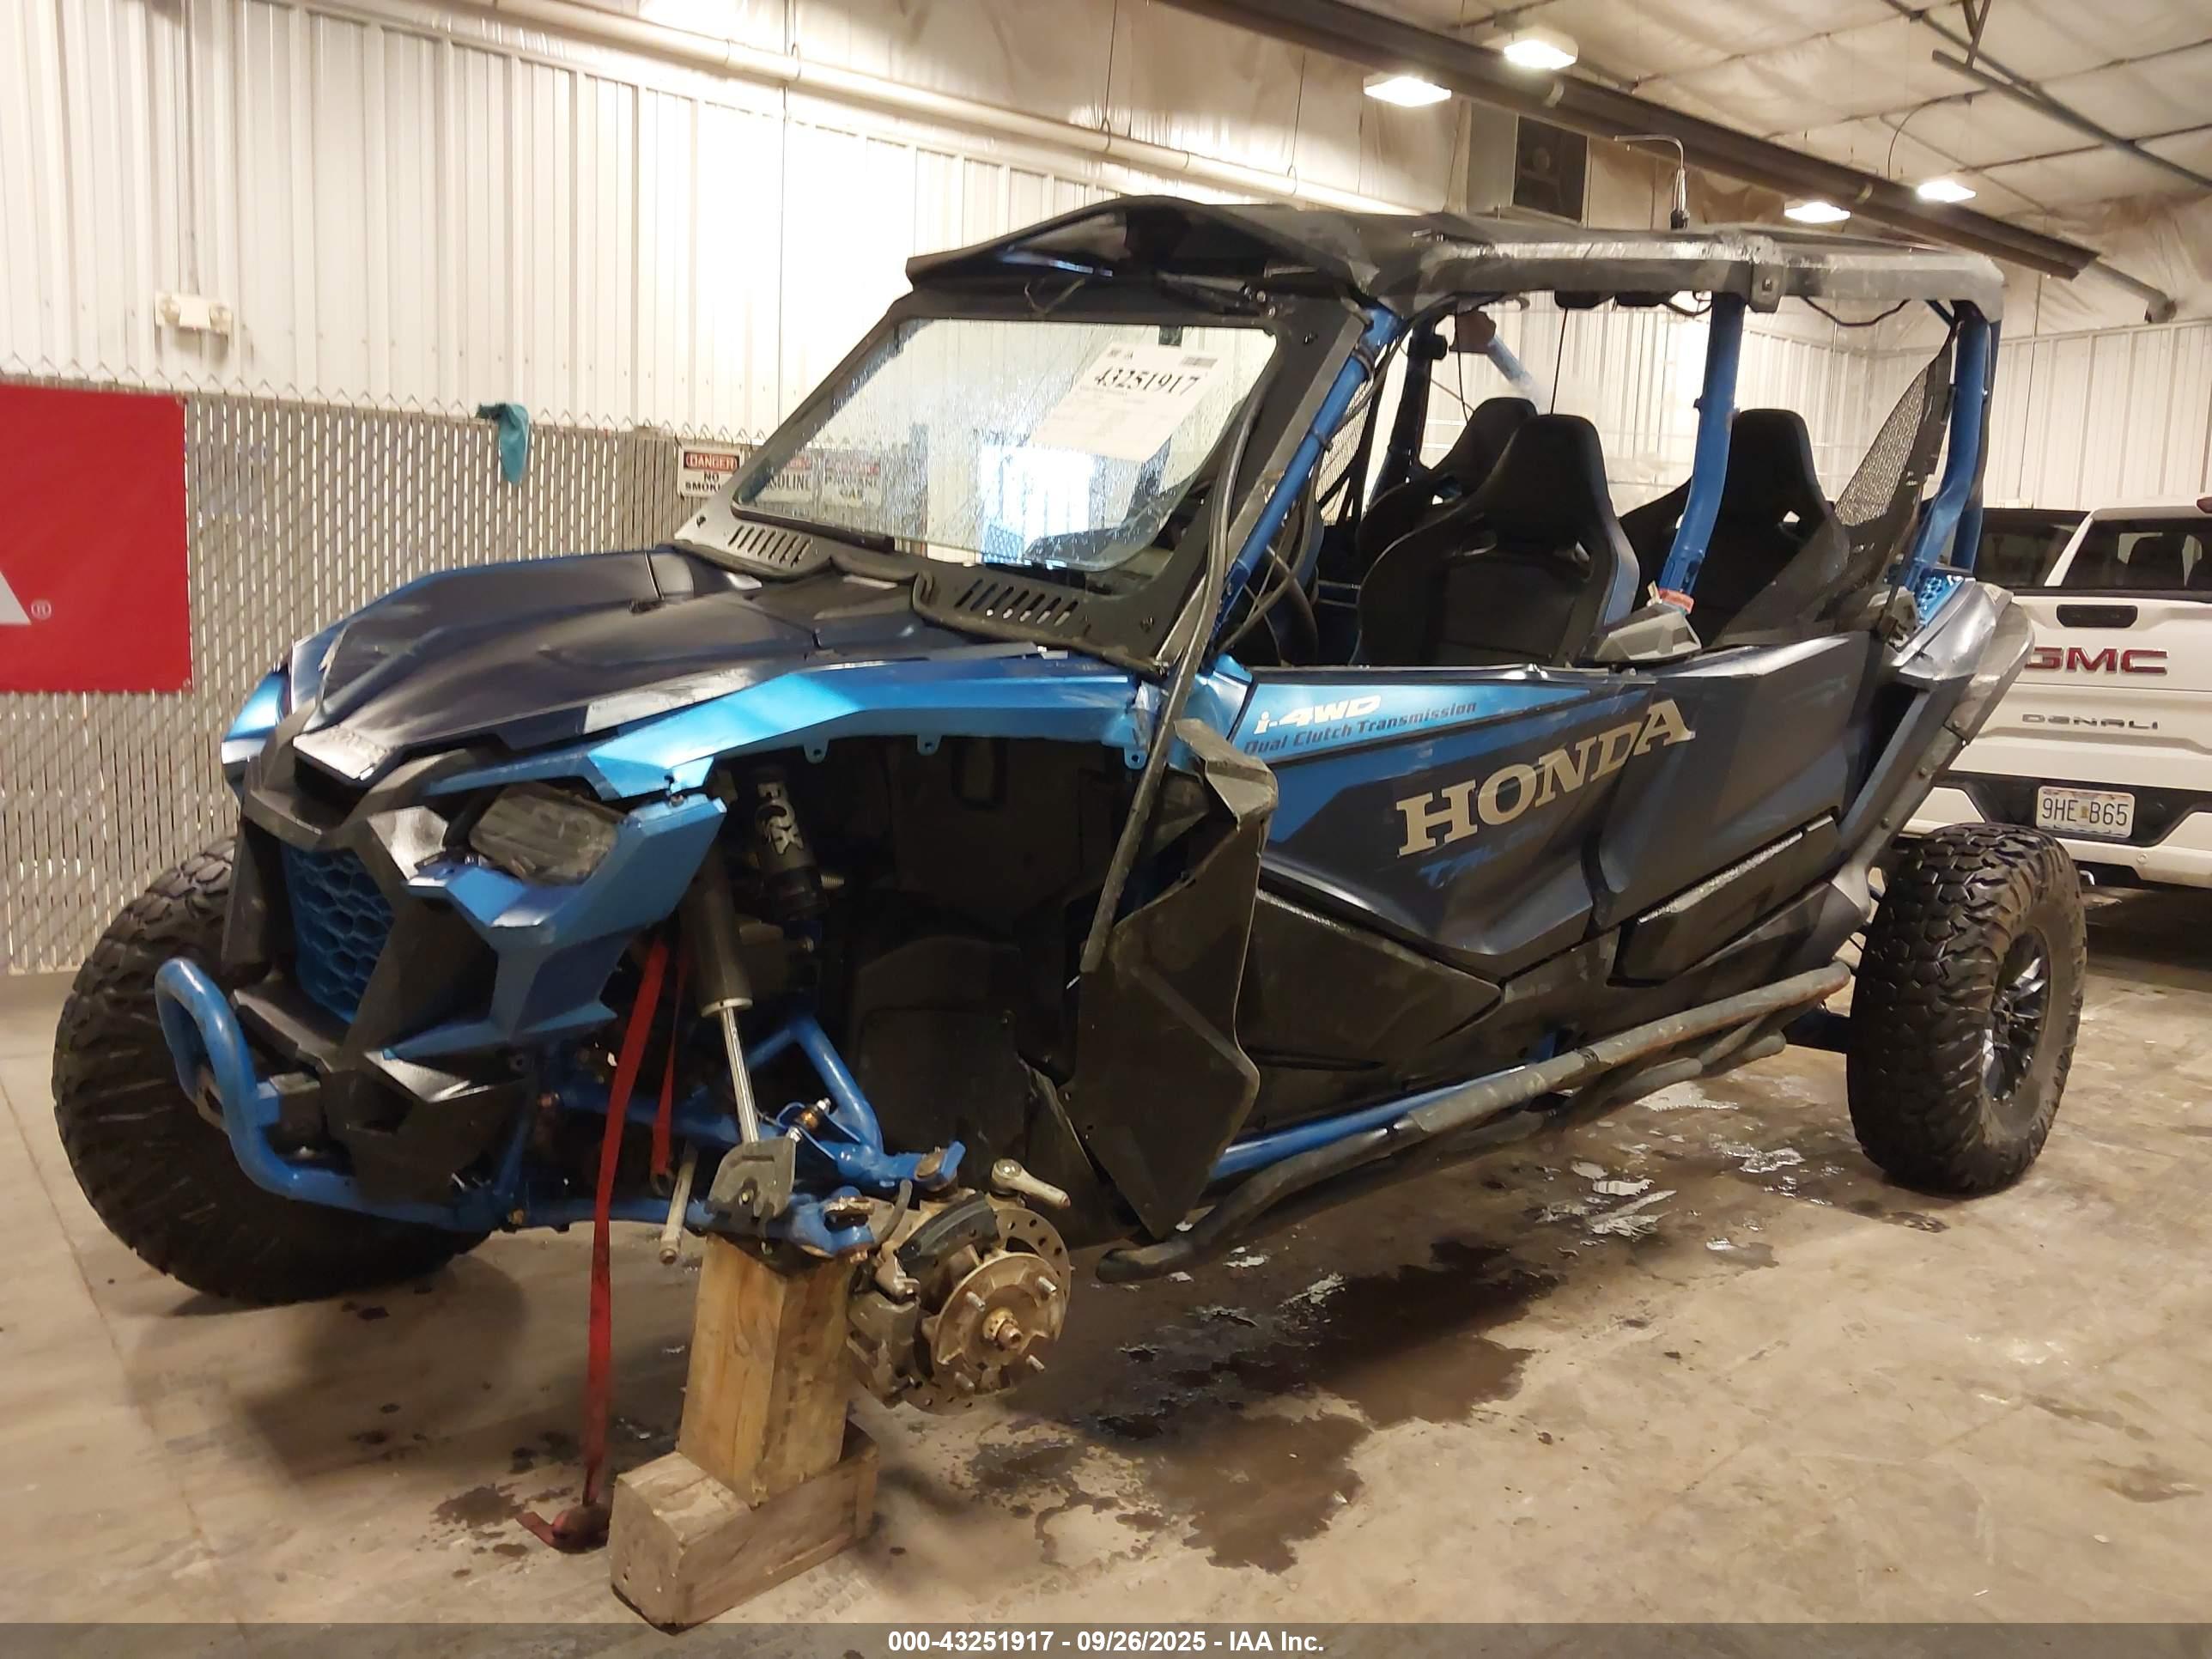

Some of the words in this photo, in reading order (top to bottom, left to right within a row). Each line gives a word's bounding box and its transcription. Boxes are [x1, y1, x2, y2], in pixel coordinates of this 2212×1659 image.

[1094, 366, 1203, 396] 43251917
[690, 453, 734, 471] DANGER
[684, 481, 721, 493] SMOKI
[703, 471, 720, 482] NO
[2024, 647, 2168, 675] GMC
[1244, 736, 1287, 756] Dual
[1293, 724, 1352, 747] Clutch
[1355, 701, 1477, 732] Transmission
[1254, 695, 1382, 735] i-4WD
[2021, 714, 2159, 730] DENALI
[1396, 699, 1696, 857] HONDA
[2041, 797, 2079, 822] 9HE
[2088, 801, 2130, 826] B65
